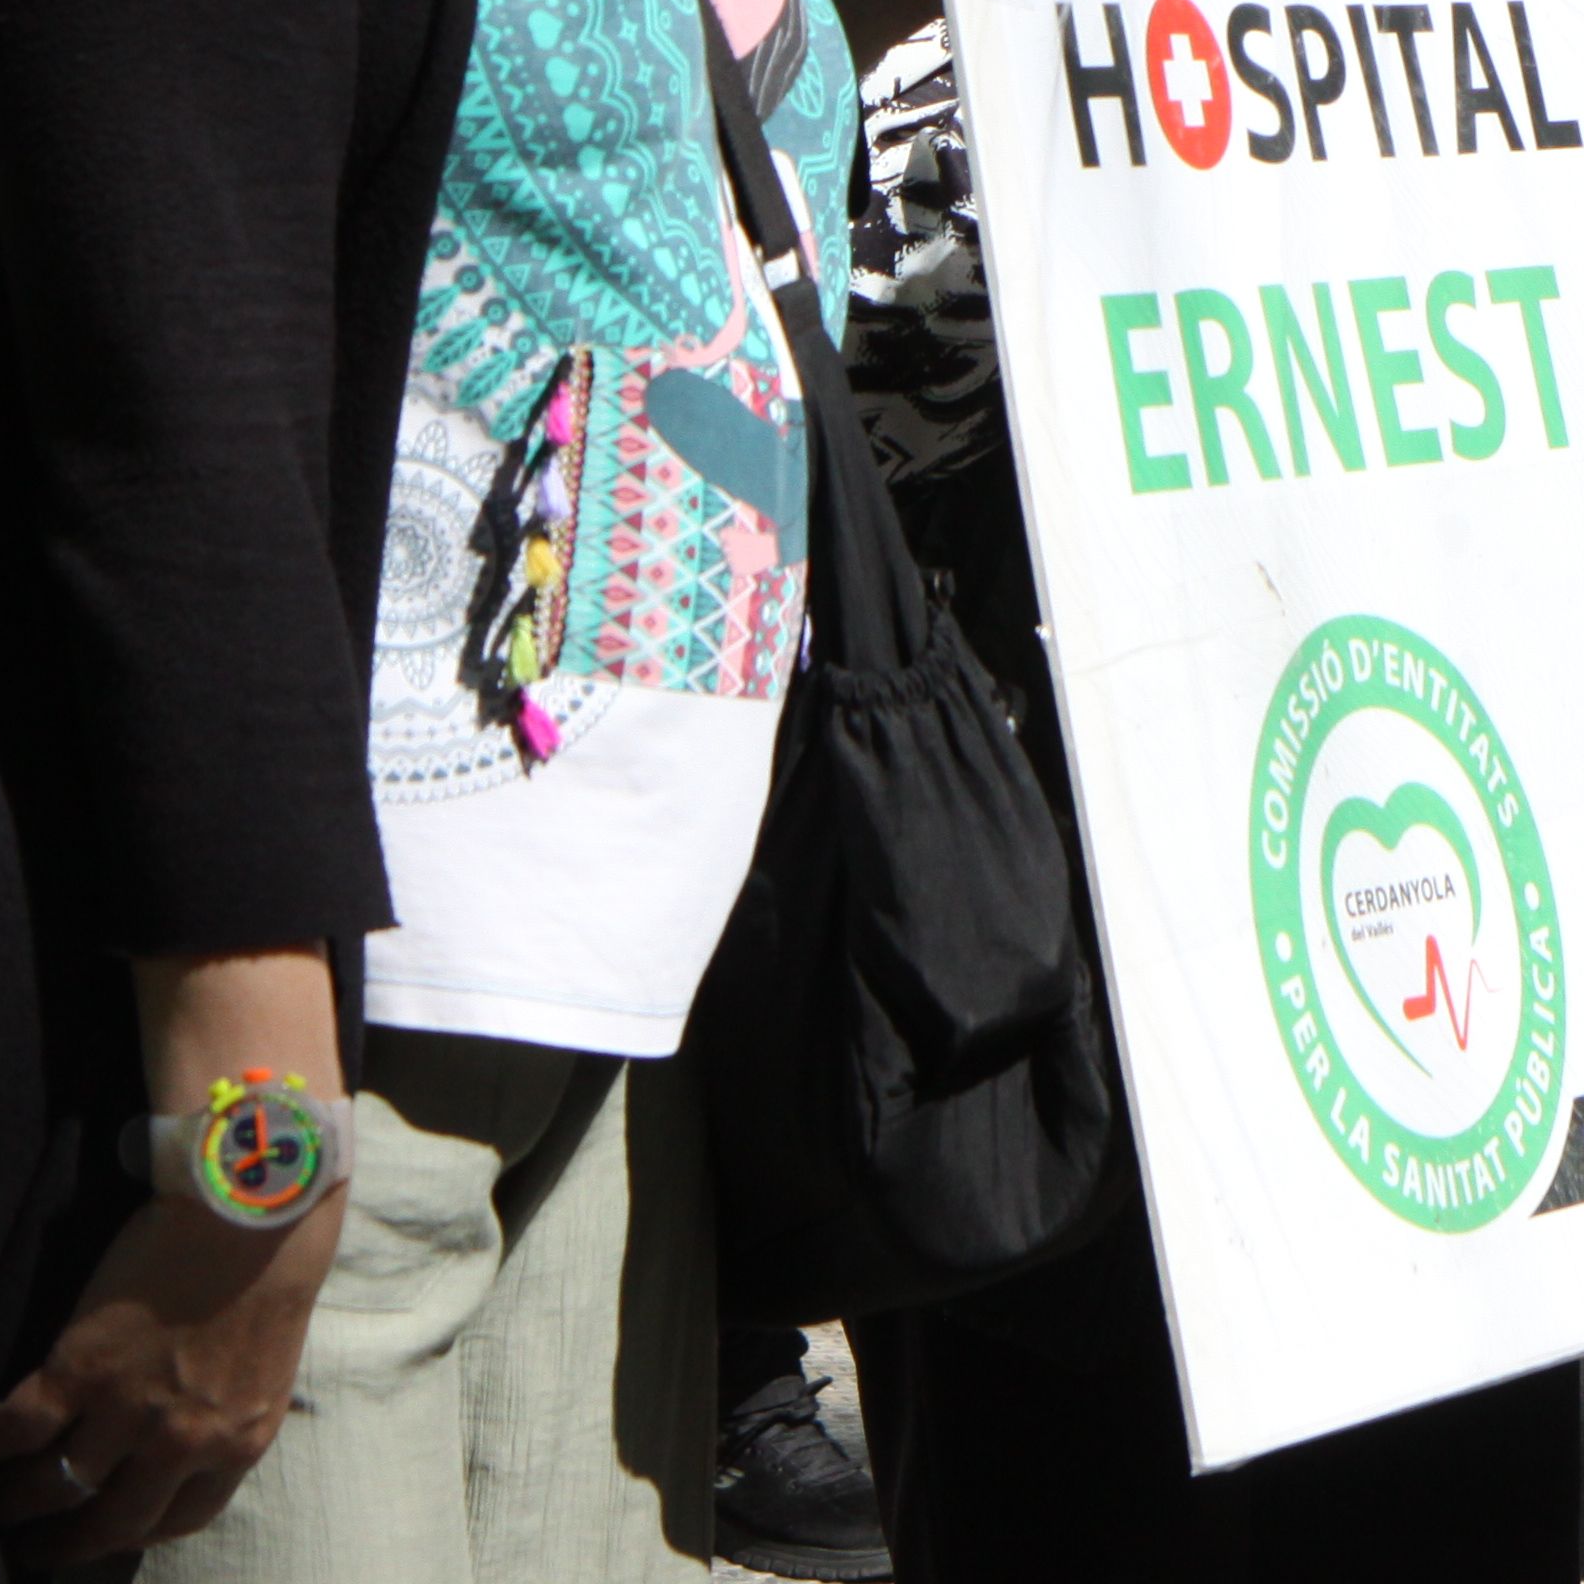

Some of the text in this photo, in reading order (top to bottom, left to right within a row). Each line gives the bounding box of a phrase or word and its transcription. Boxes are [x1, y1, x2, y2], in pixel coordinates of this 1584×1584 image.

[1101, 264, 1570, 496] ERNEST
[1259, 637, 1520, 869] COMISSIÓ D'ENTITATS
[1345, 873, 1456, 918] CERDANYOLA
[1279, 926, 1550, 1210] PER LA SANITAT PÚBLICA
